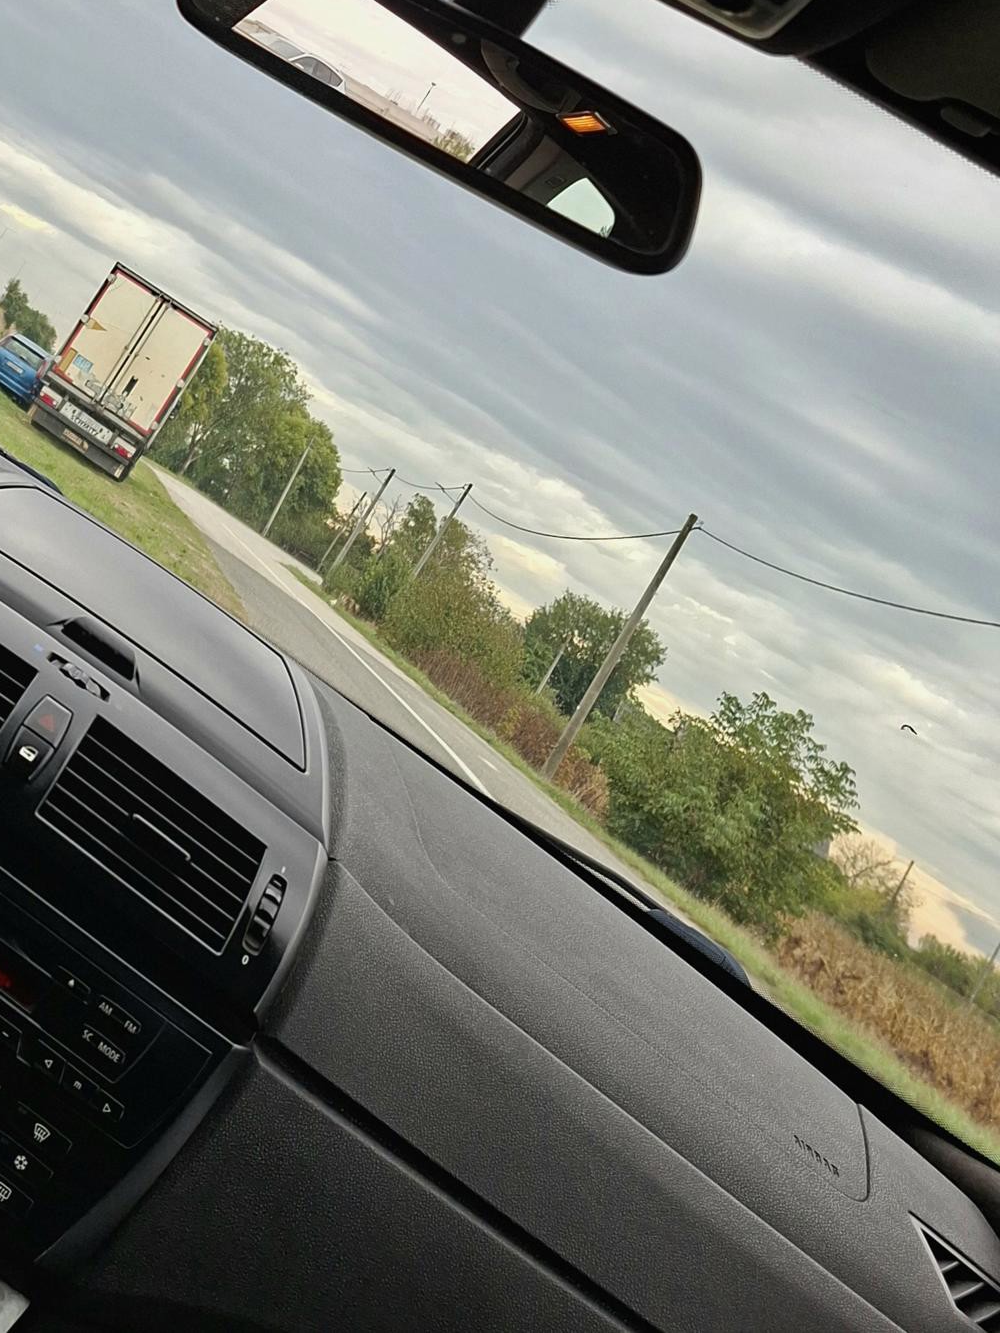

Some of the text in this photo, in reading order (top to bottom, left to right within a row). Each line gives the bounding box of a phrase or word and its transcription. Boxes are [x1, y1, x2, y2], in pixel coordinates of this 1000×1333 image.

[98, 1000, 138, 1035] AM FM
[97, 1040, 122, 1064] MODE
